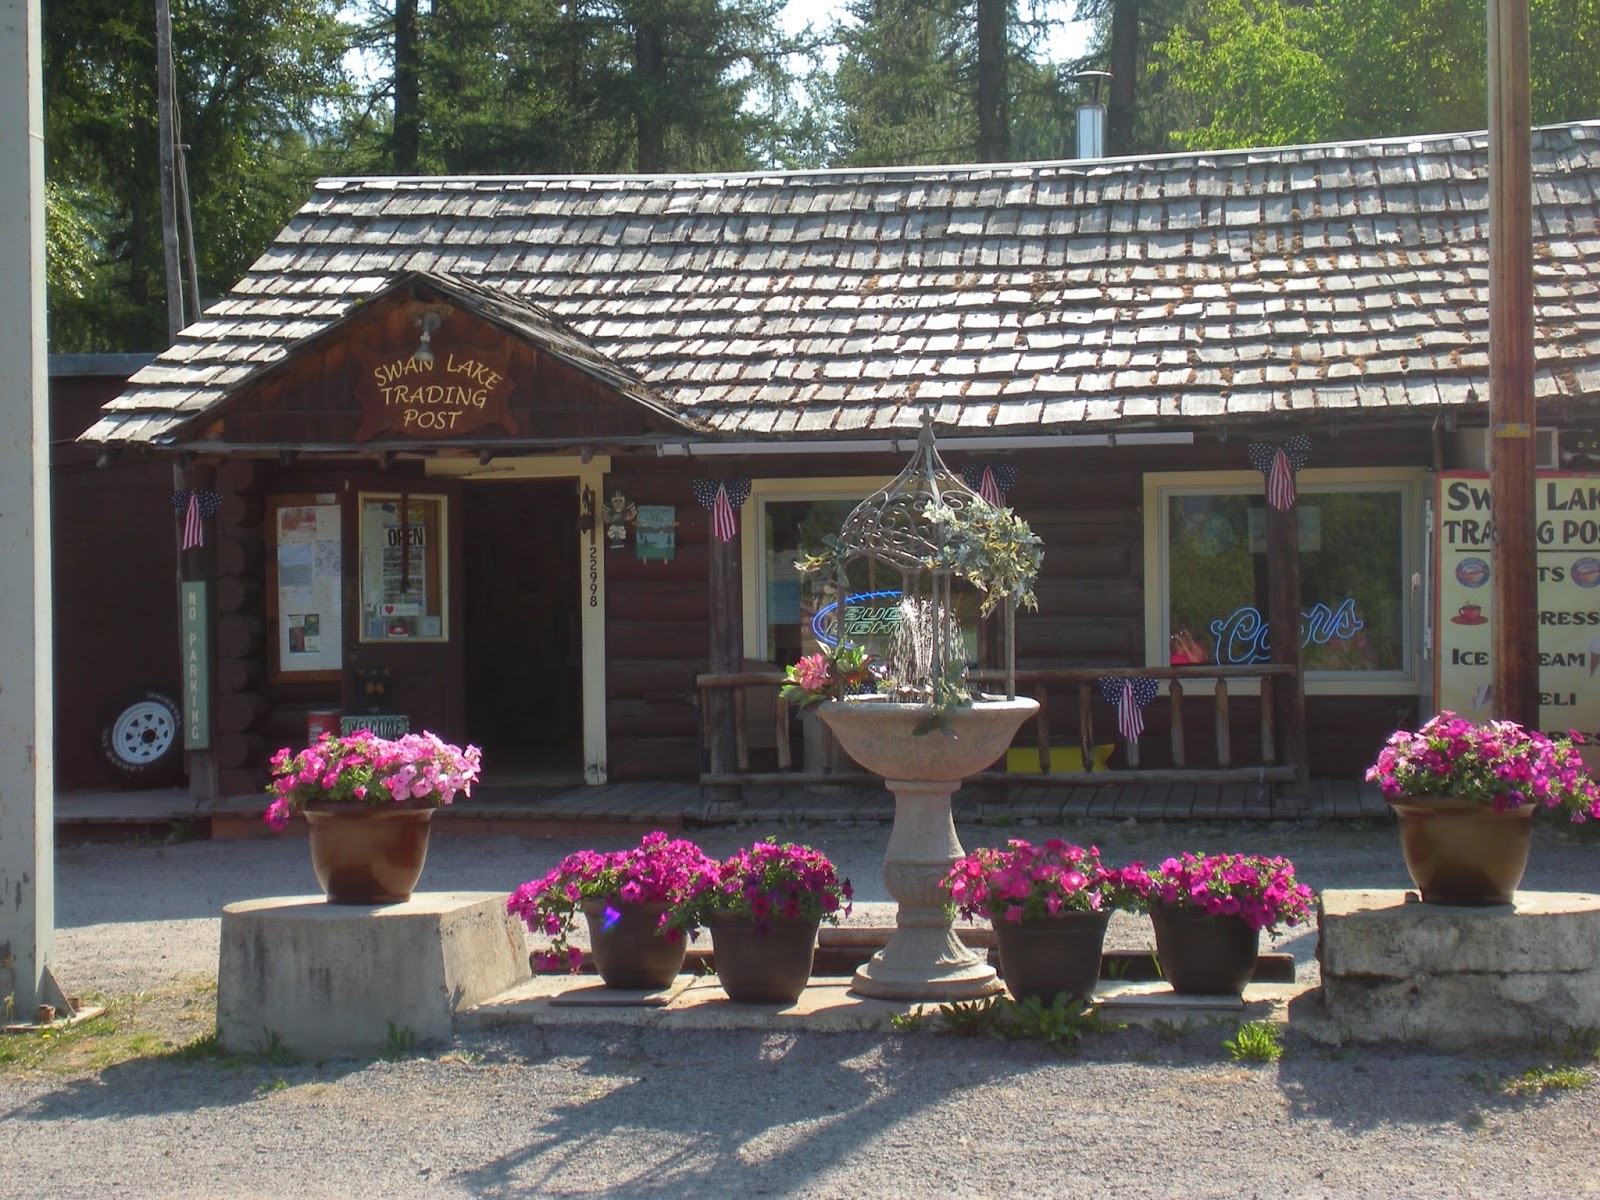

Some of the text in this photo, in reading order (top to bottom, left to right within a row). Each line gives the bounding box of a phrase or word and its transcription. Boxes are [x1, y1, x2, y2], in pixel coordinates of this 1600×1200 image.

[374, 353, 503, 390] SWAN LAKE
[380, 384, 488, 409] TRADING
[403, 408, 463, 430] POST
[1447, 481, 1600, 511] SW LAK
[589, 546, 598, 608] 22998
[188, 592, 199, 740] NO PARKING
[1451, 648, 1586, 667] ICE EAM
[1538, 692, 1577, 706] ELI
